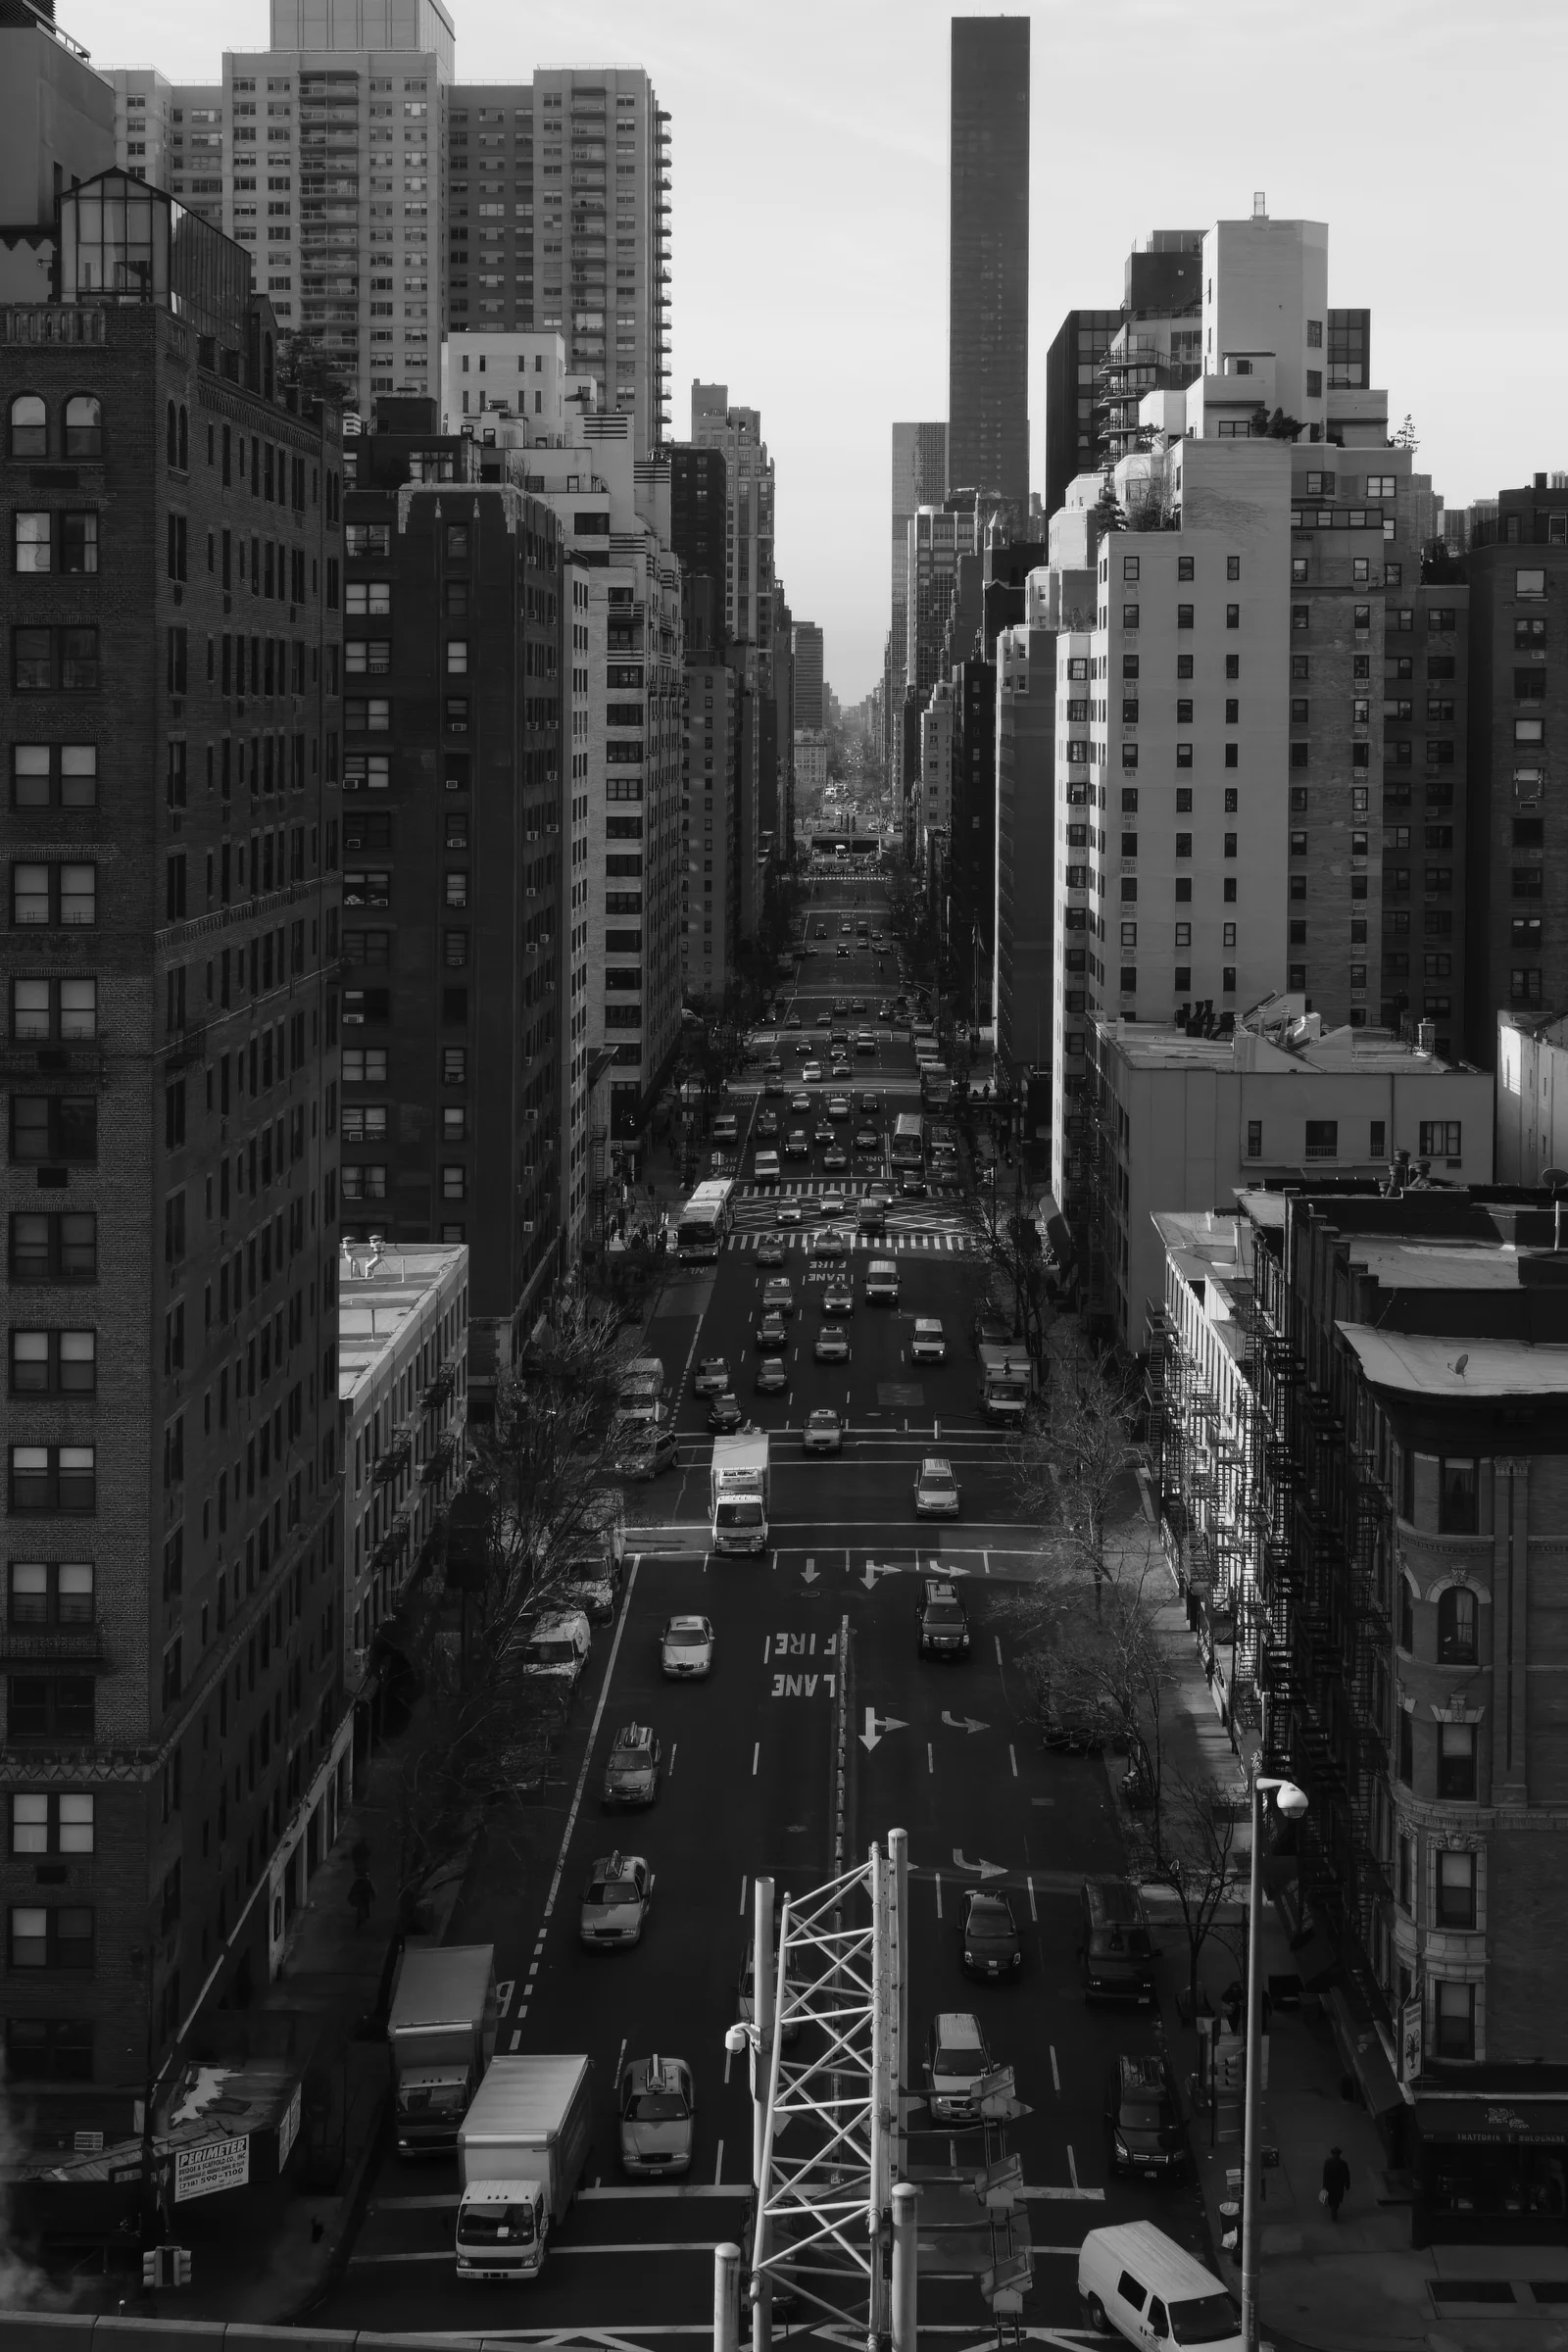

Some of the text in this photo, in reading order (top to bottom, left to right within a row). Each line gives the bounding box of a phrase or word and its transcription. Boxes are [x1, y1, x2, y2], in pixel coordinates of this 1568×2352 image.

[808, 1260, 847, 1269] FIRE
[808, 1273, 846, 1282] LANE
[774, 1633, 837, 1655] FIRE
[771, 1674, 836, 1697] LANE
[1457, 2132, 1501, 2141] TRATTORIA
[1518, 2134, 1567, 2143] BOLOGNESE
[179, 2138, 246, 2167] PERIMETER
